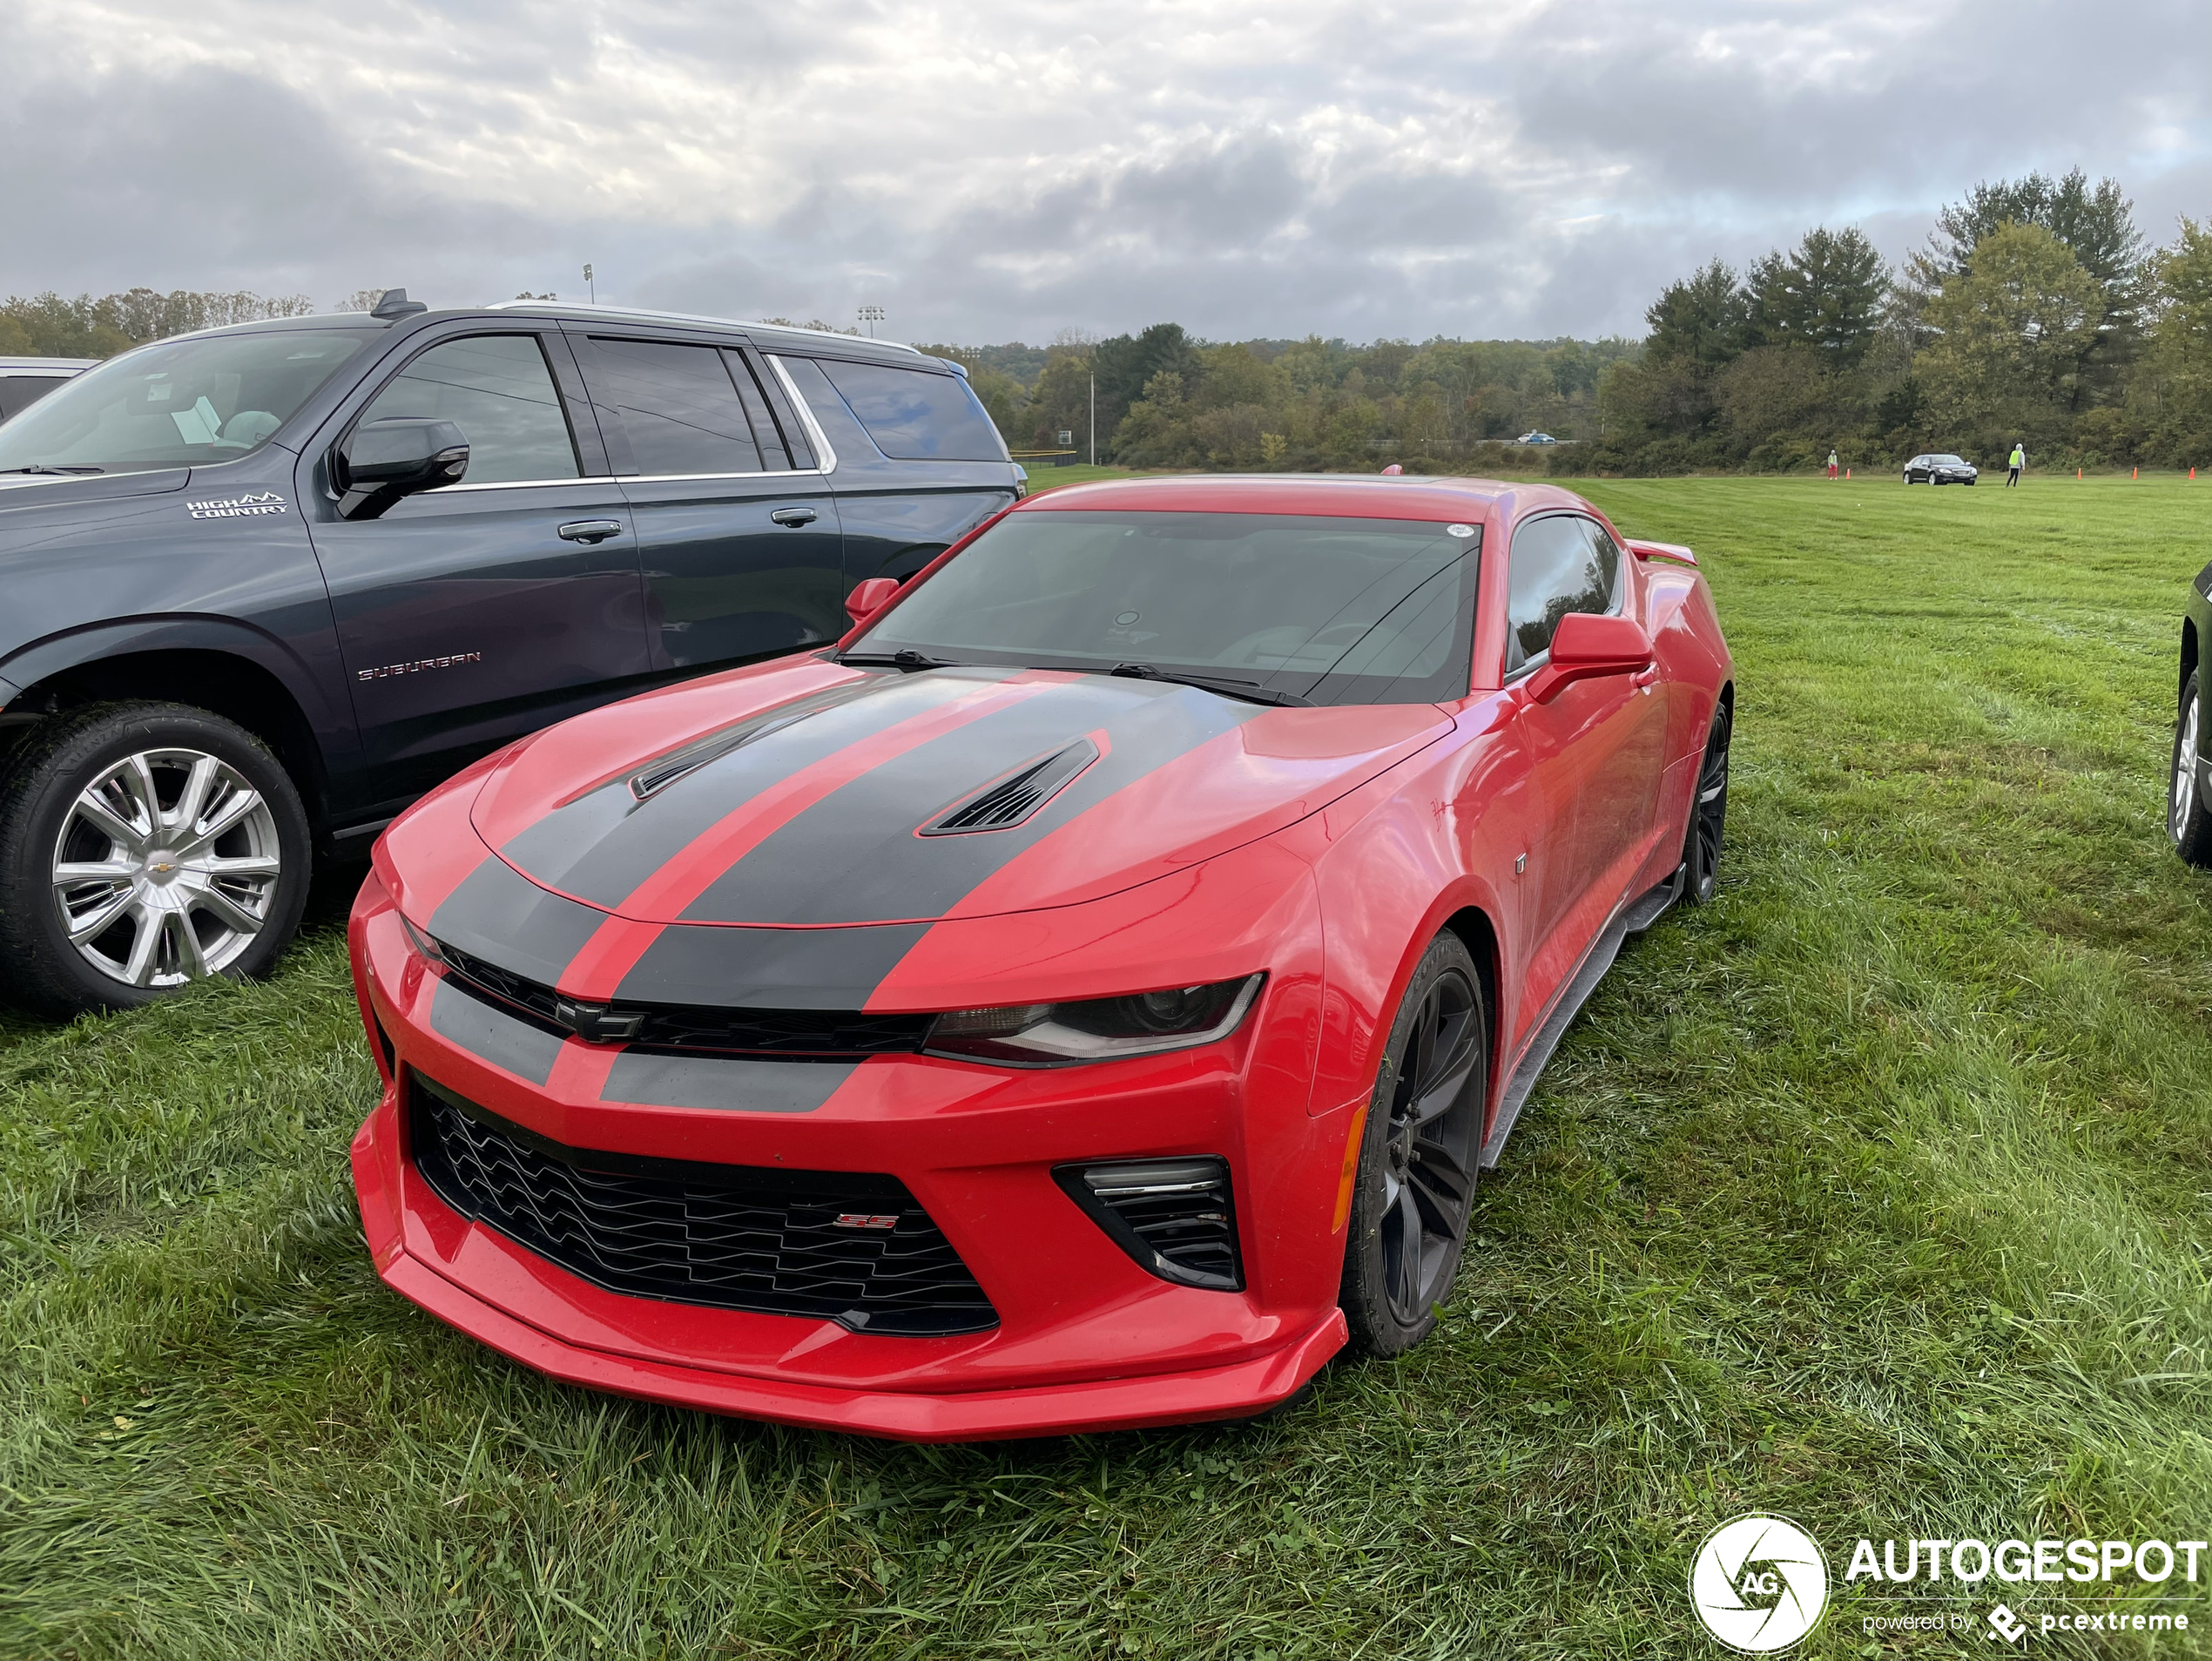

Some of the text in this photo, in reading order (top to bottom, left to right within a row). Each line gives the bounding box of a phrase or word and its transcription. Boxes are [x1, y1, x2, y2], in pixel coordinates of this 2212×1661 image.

[185, 499, 240, 511] HIGH
[191, 504, 287, 519] COUNTRY
[357, 652, 482, 681] SUBURBAN
[833, 1213, 900, 1229] SS
